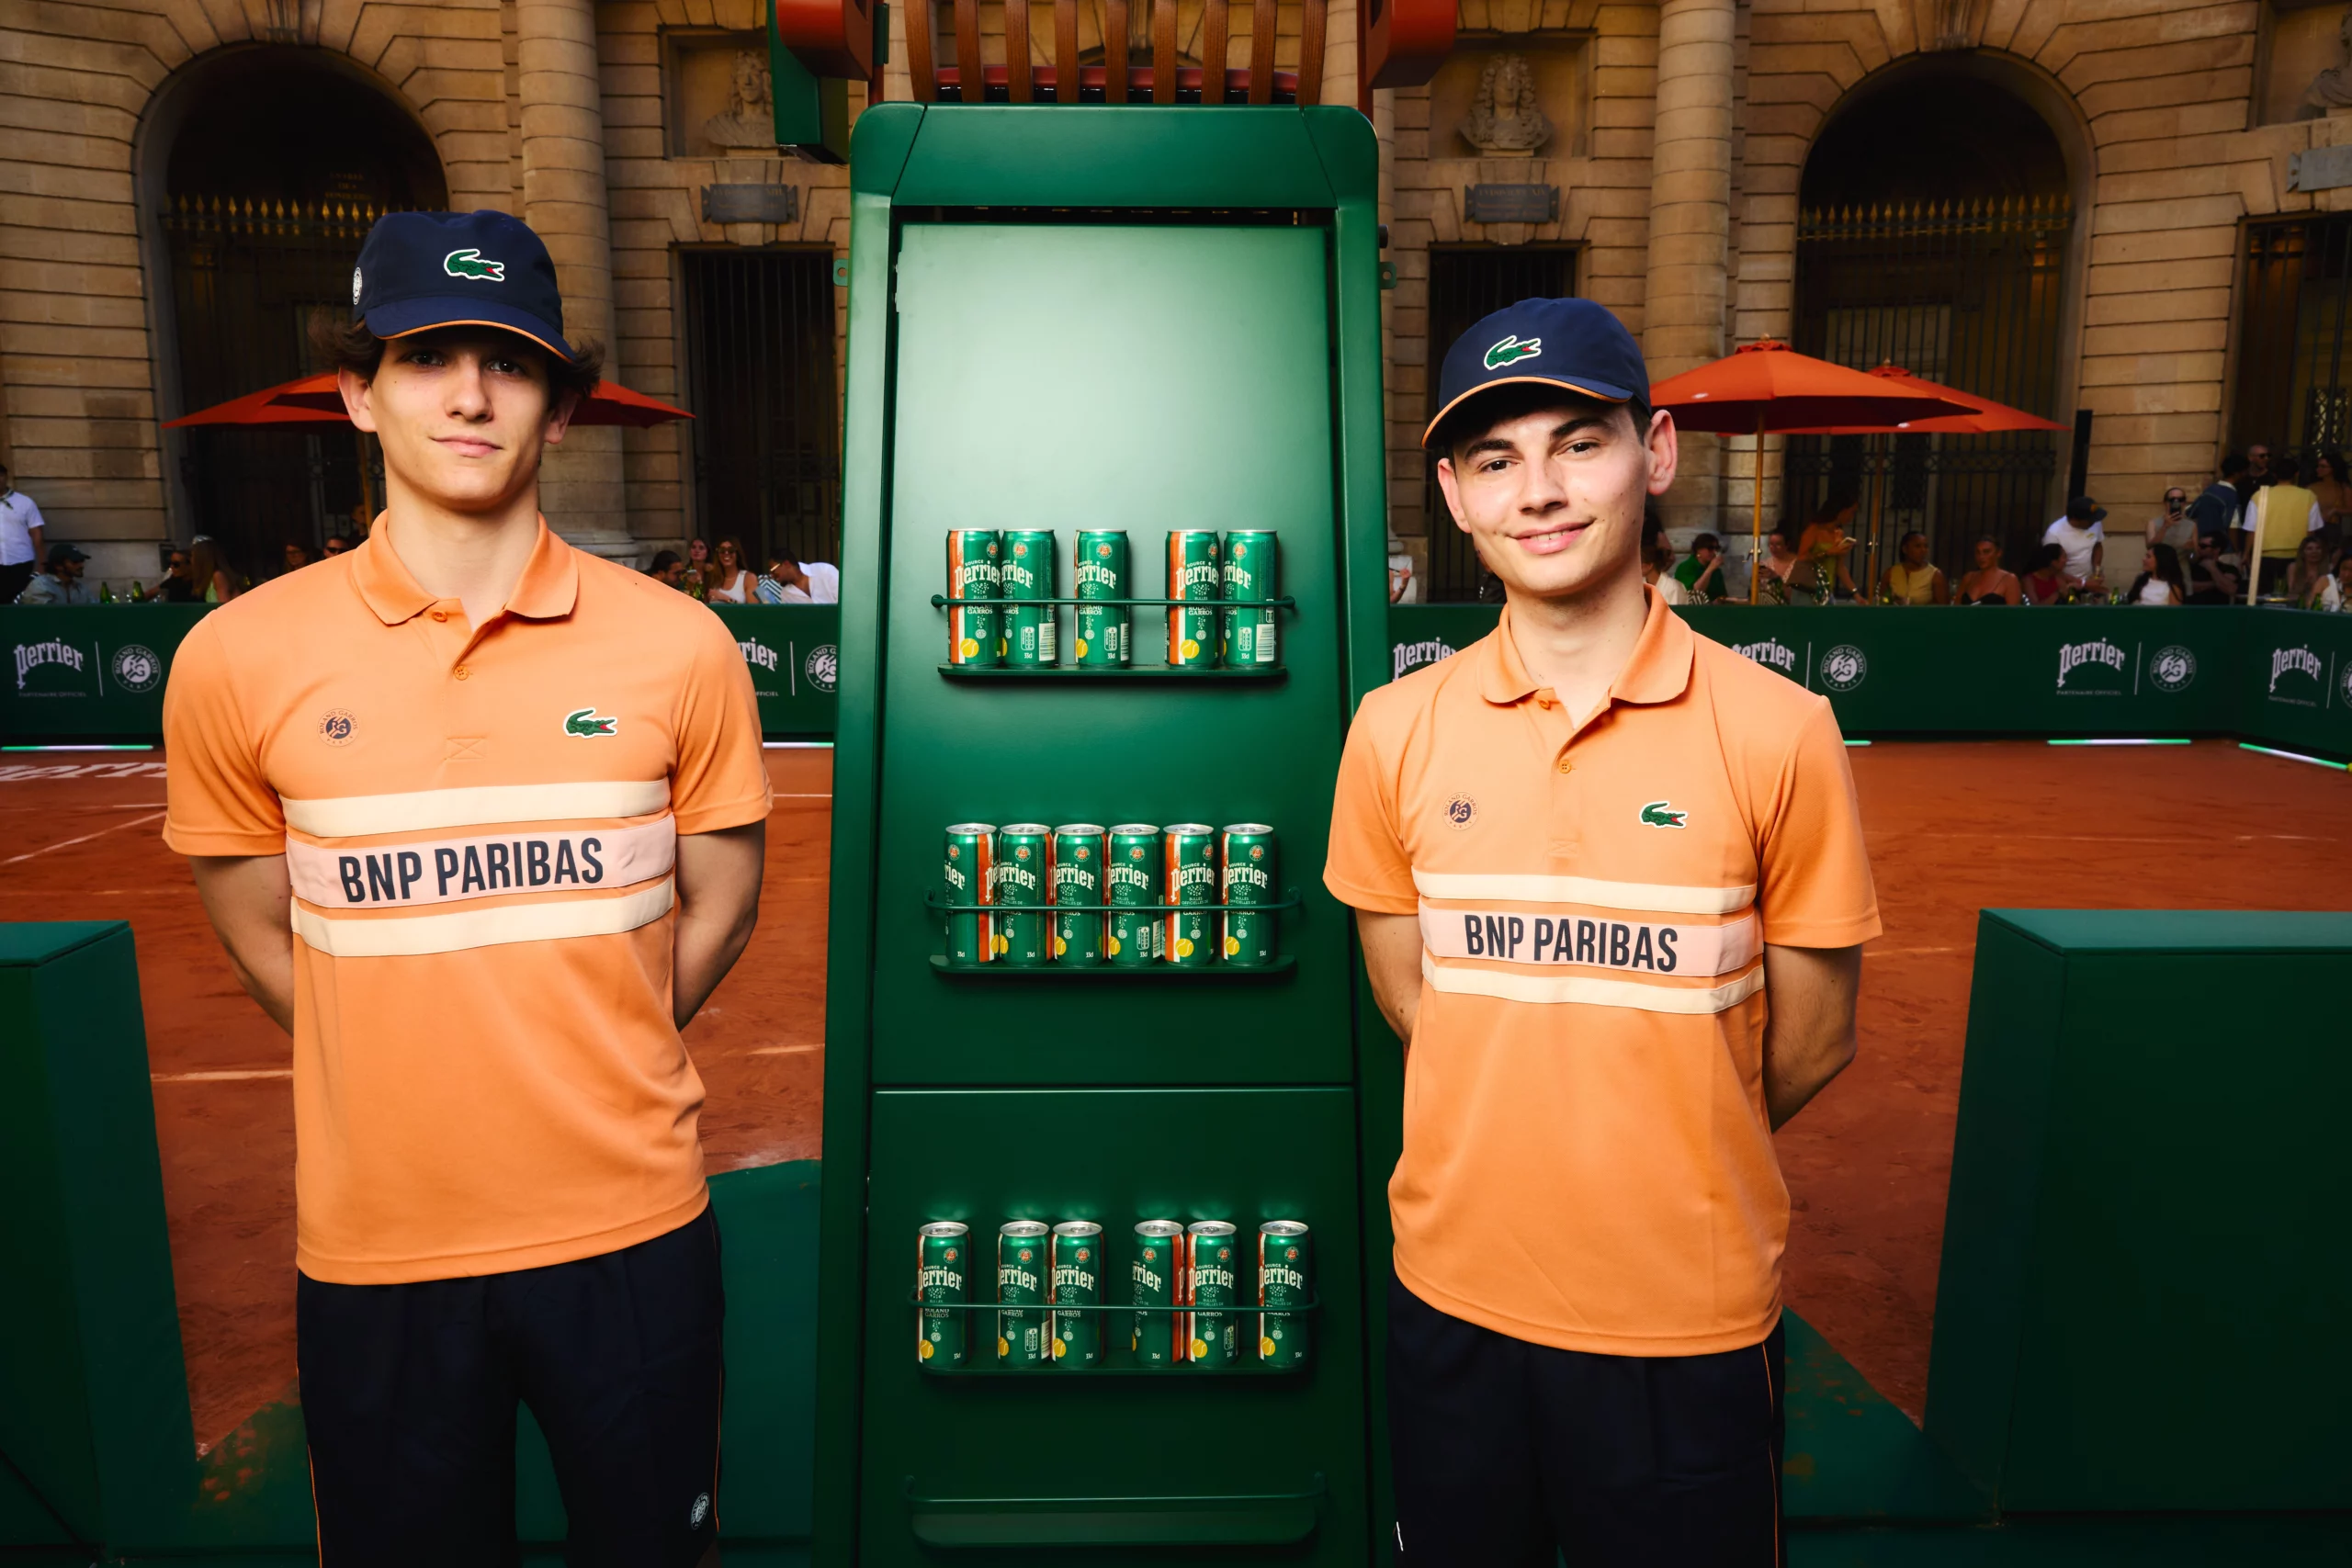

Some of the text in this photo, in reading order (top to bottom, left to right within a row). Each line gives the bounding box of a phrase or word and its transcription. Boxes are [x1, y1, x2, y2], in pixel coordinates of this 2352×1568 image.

[1001, 560, 1034, 588] rrier
[1224, 560, 1251, 590] rrier
[115, 648, 159, 674] ROLAND GARROS
[737, 637, 777, 672] rier
[808, 648, 828, 674] ROLAND
[1732, 637, 1795, 671] errier
[1824, 648, 1864, 673] ROLAND GARROS
[2153, 649, 2192, 673] ROLAND GARROS
[123, 680, 153, 689] PARIS
[815, 680, 832, 689] PAR
[0, 762, 166, 781] err
[338, 838, 604, 902] BNP PARIBAS
[944, 862, 965, 890] rier
[1000, 863, 1035, 890] errier
[1464, 914, 1678, 973] BNP PARIBAS
[999, 1266, 1037, 1292] errier
[1133, 1264, 1161, 1292] rrier
